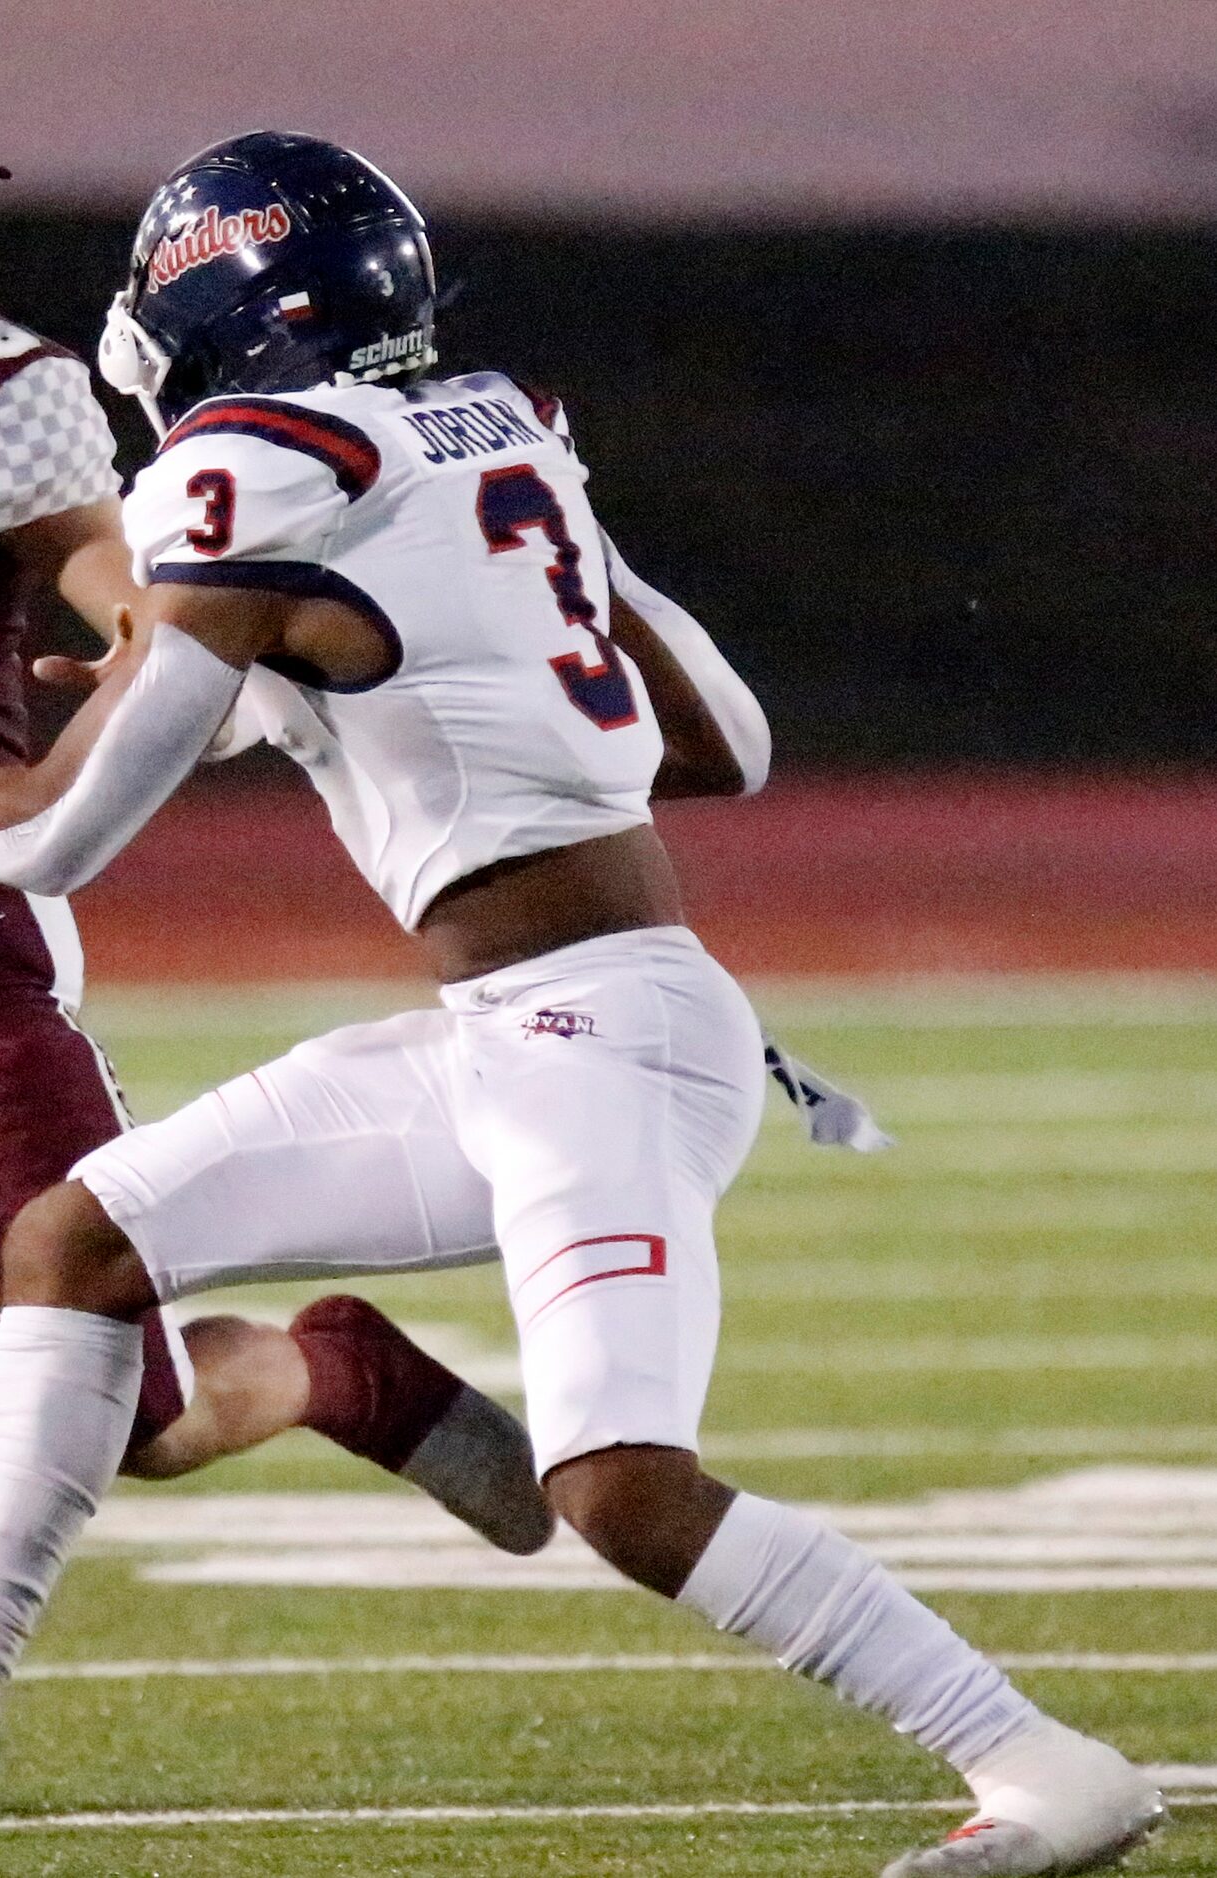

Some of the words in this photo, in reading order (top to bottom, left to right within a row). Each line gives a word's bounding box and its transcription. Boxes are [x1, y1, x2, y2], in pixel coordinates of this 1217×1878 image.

[148, 203, 291, 294] Raiders
[378, 270, 394, 297] 3
[401, 399, 544, 464] JORDAN
[186, 468, 237, 557] 3
[476, 463, 639, 731] 3
[524, 1013, 596, 1037] RYAN
